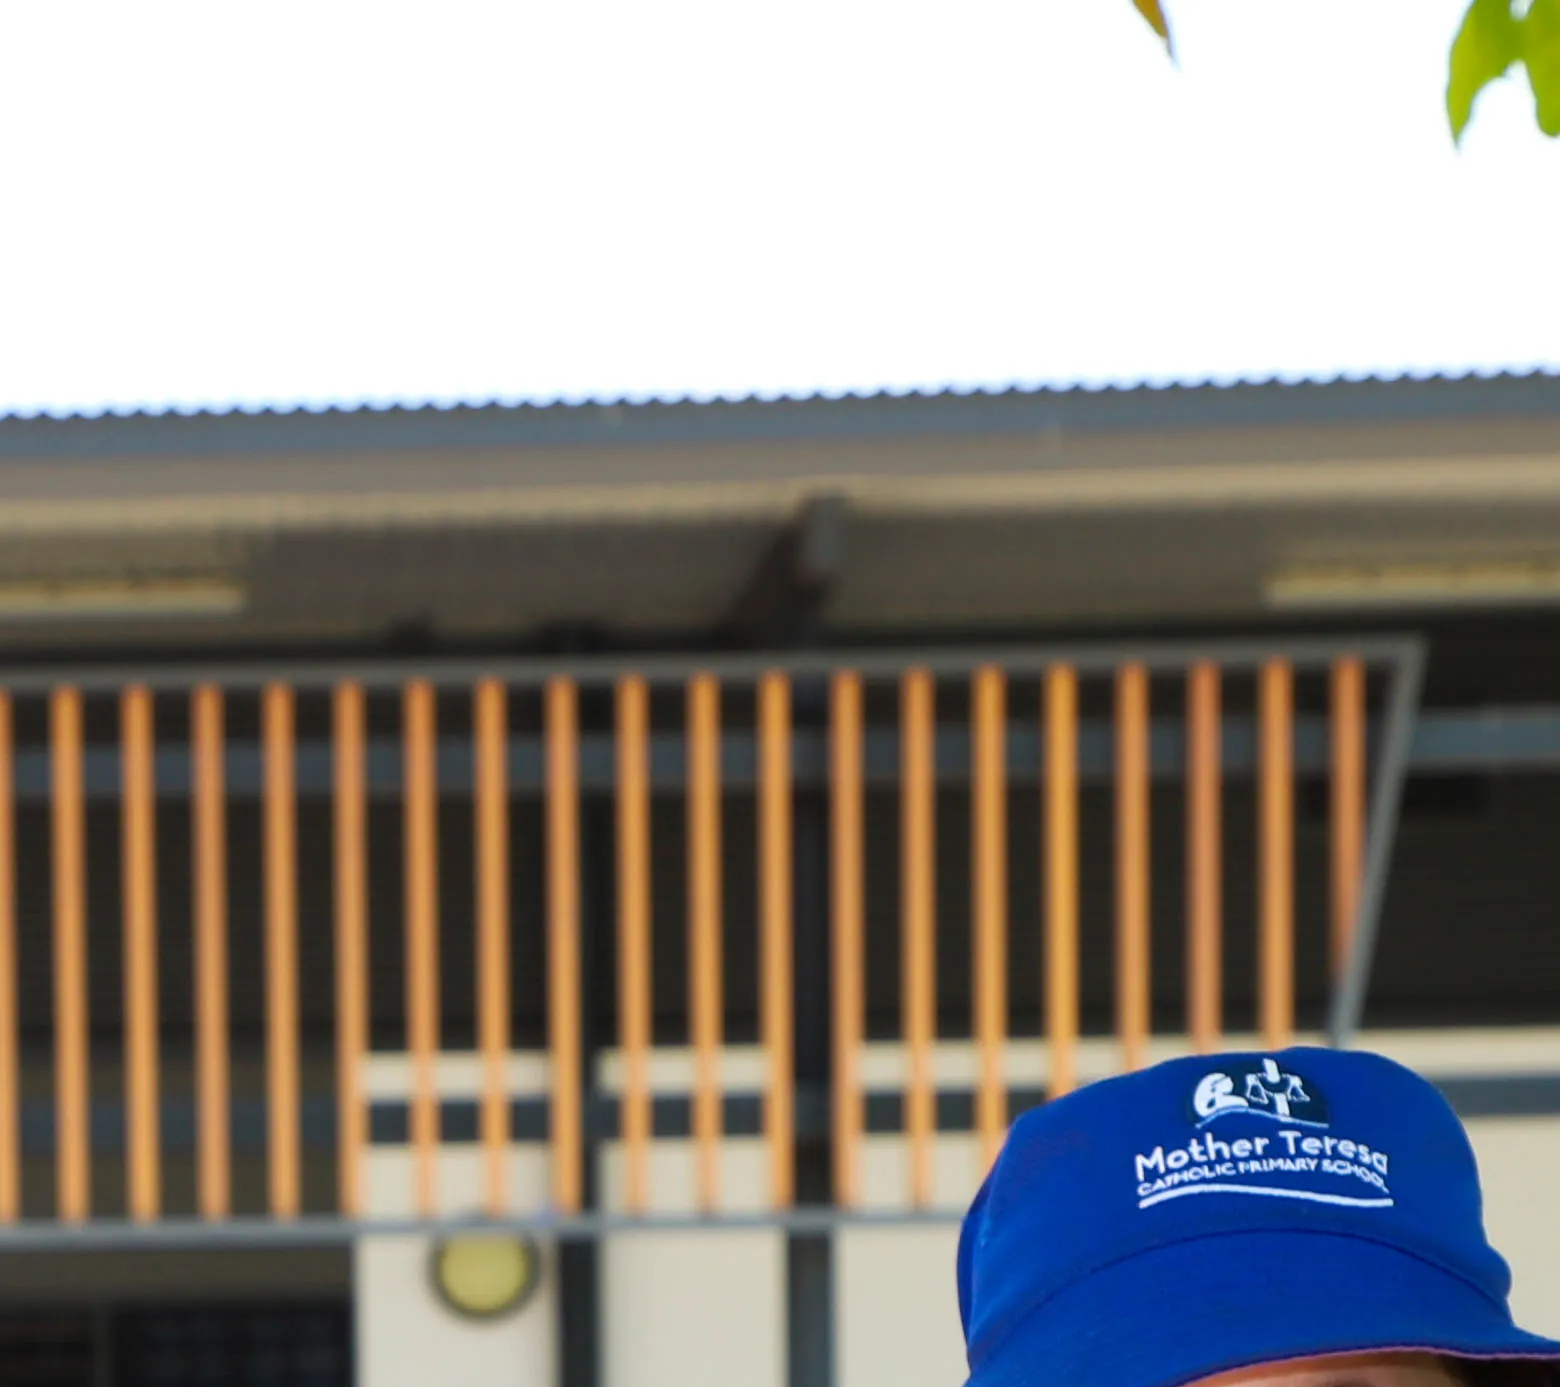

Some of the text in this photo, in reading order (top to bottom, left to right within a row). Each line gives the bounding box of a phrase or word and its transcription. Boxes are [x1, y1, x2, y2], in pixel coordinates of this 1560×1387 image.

[1134, 1130, 1391, 1182] Mother Teresa
[1137, 1157, 1389, 1195] CATHOLIC PRIMARY SCHOOL
